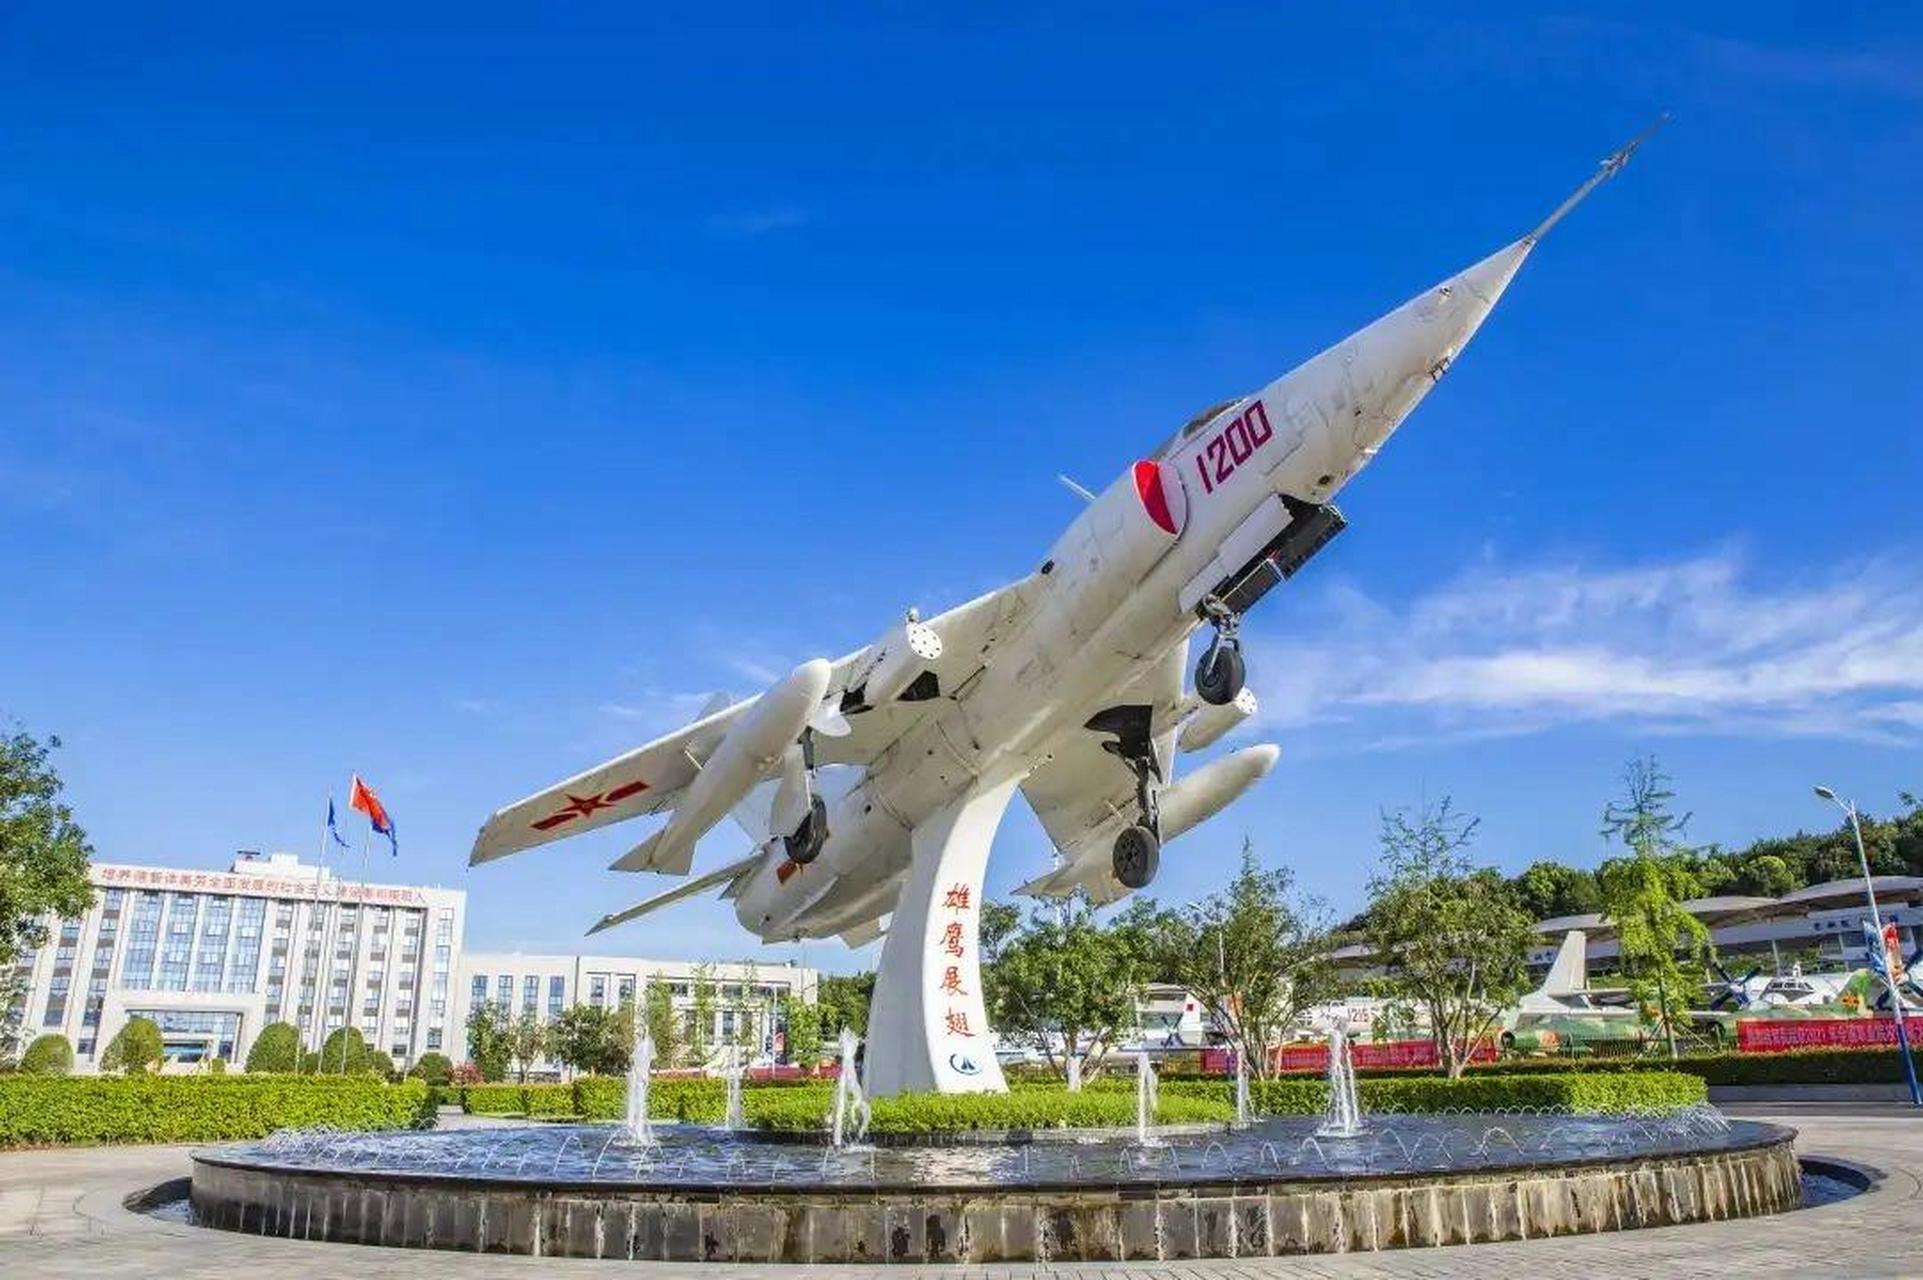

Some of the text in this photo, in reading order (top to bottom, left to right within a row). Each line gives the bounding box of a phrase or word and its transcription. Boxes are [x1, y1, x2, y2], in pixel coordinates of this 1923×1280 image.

[1195, 399, 1273, 494] 1200
[939, 881, 976, 1038] 雄鹰展翅
